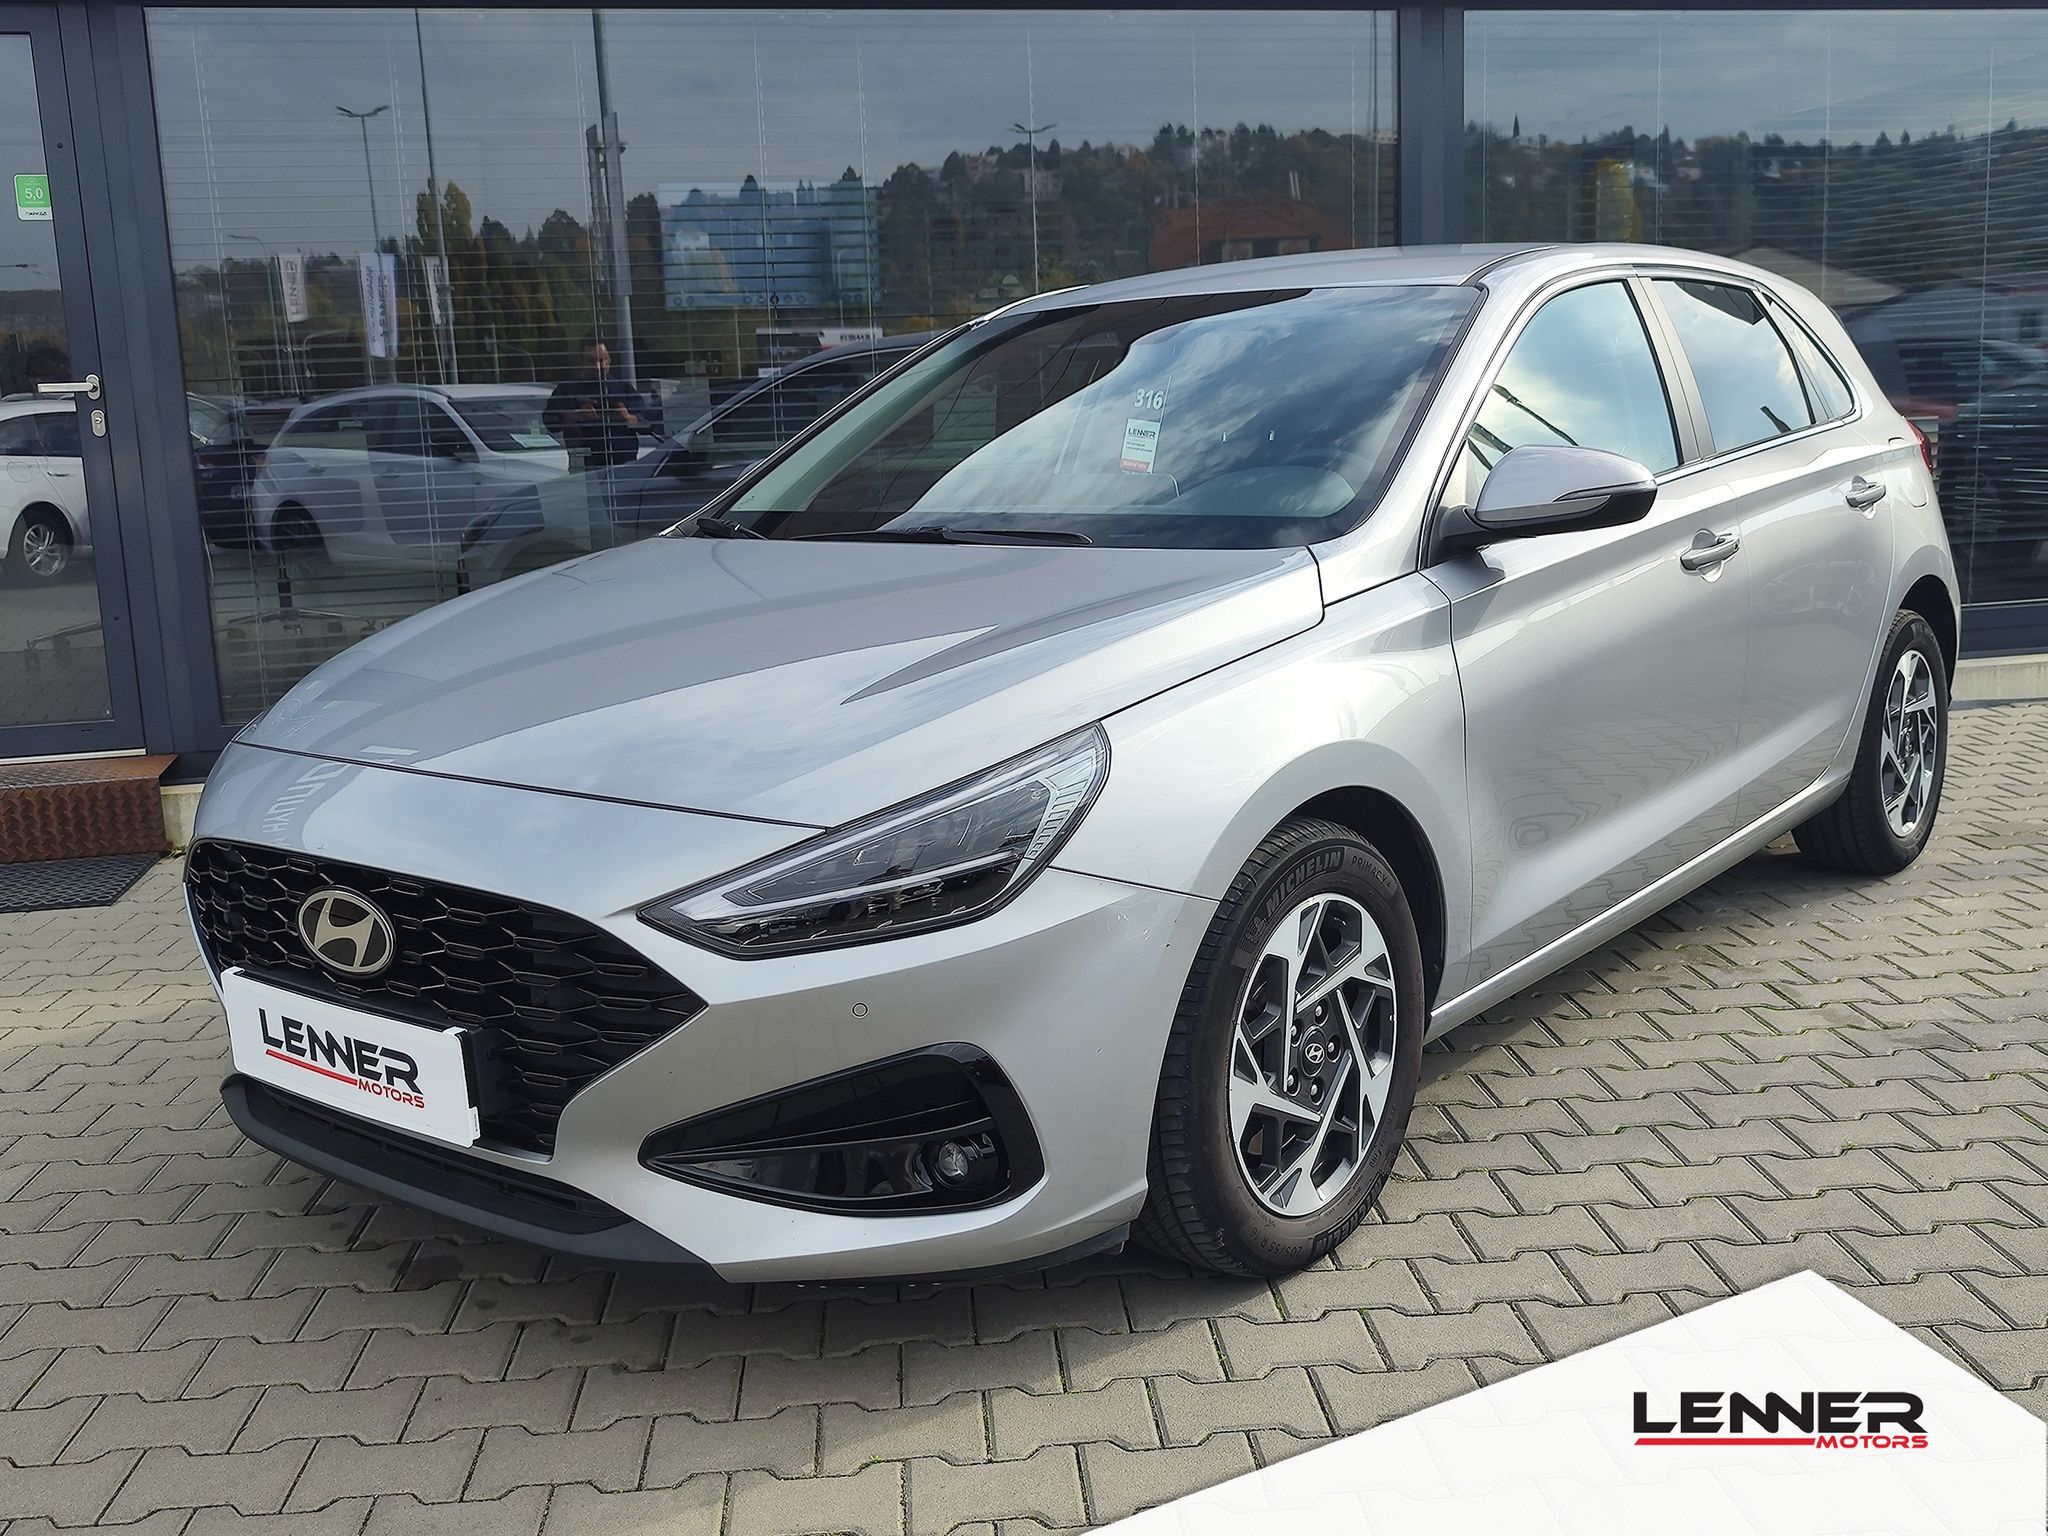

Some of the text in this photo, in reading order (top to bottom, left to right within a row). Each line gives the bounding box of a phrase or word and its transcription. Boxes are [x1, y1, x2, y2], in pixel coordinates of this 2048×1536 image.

[25, 187, 43, 200] 5,0
[1133, 387, 1164, 410] 316
[1128, 427, 1156, 438] LENNER
[1351, 855, 1388, 884] PRIMACY
[1266, 851, 1341, 918] MICHELIN
[258, 1007, 423, 1095] LENNER
[358, 1078, 425, 1109] MOTORS
